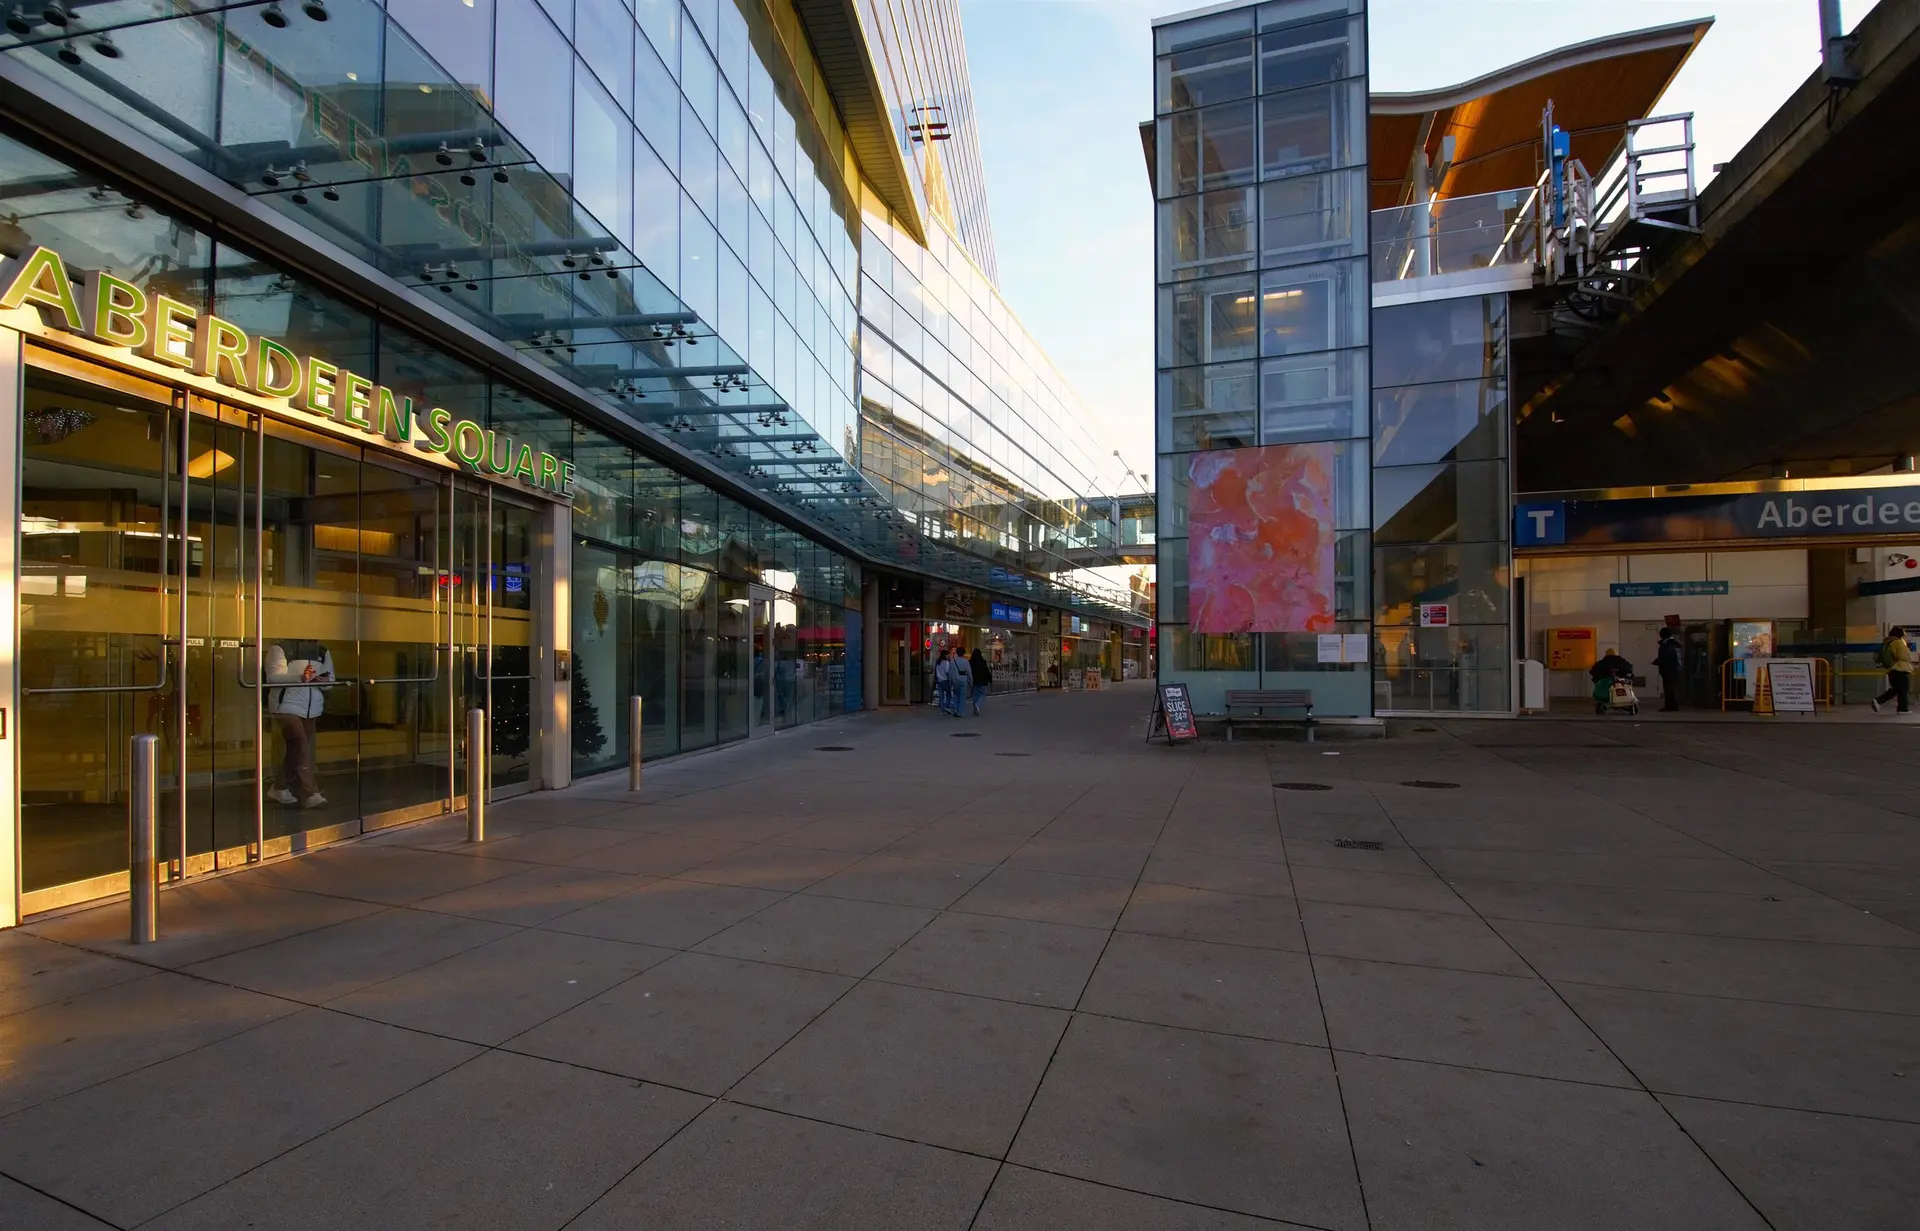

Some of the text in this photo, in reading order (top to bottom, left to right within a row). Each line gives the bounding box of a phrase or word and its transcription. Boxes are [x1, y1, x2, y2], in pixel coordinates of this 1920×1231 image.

[0, 245, 413, 443] ABERDEEN
[428, 407, 577, 500] SQUARE
[1527, 509, 1555, 539] T
[1756, 495, 1920, 529] Aberdee
[1166, 701, 1187, 712] SLICE
